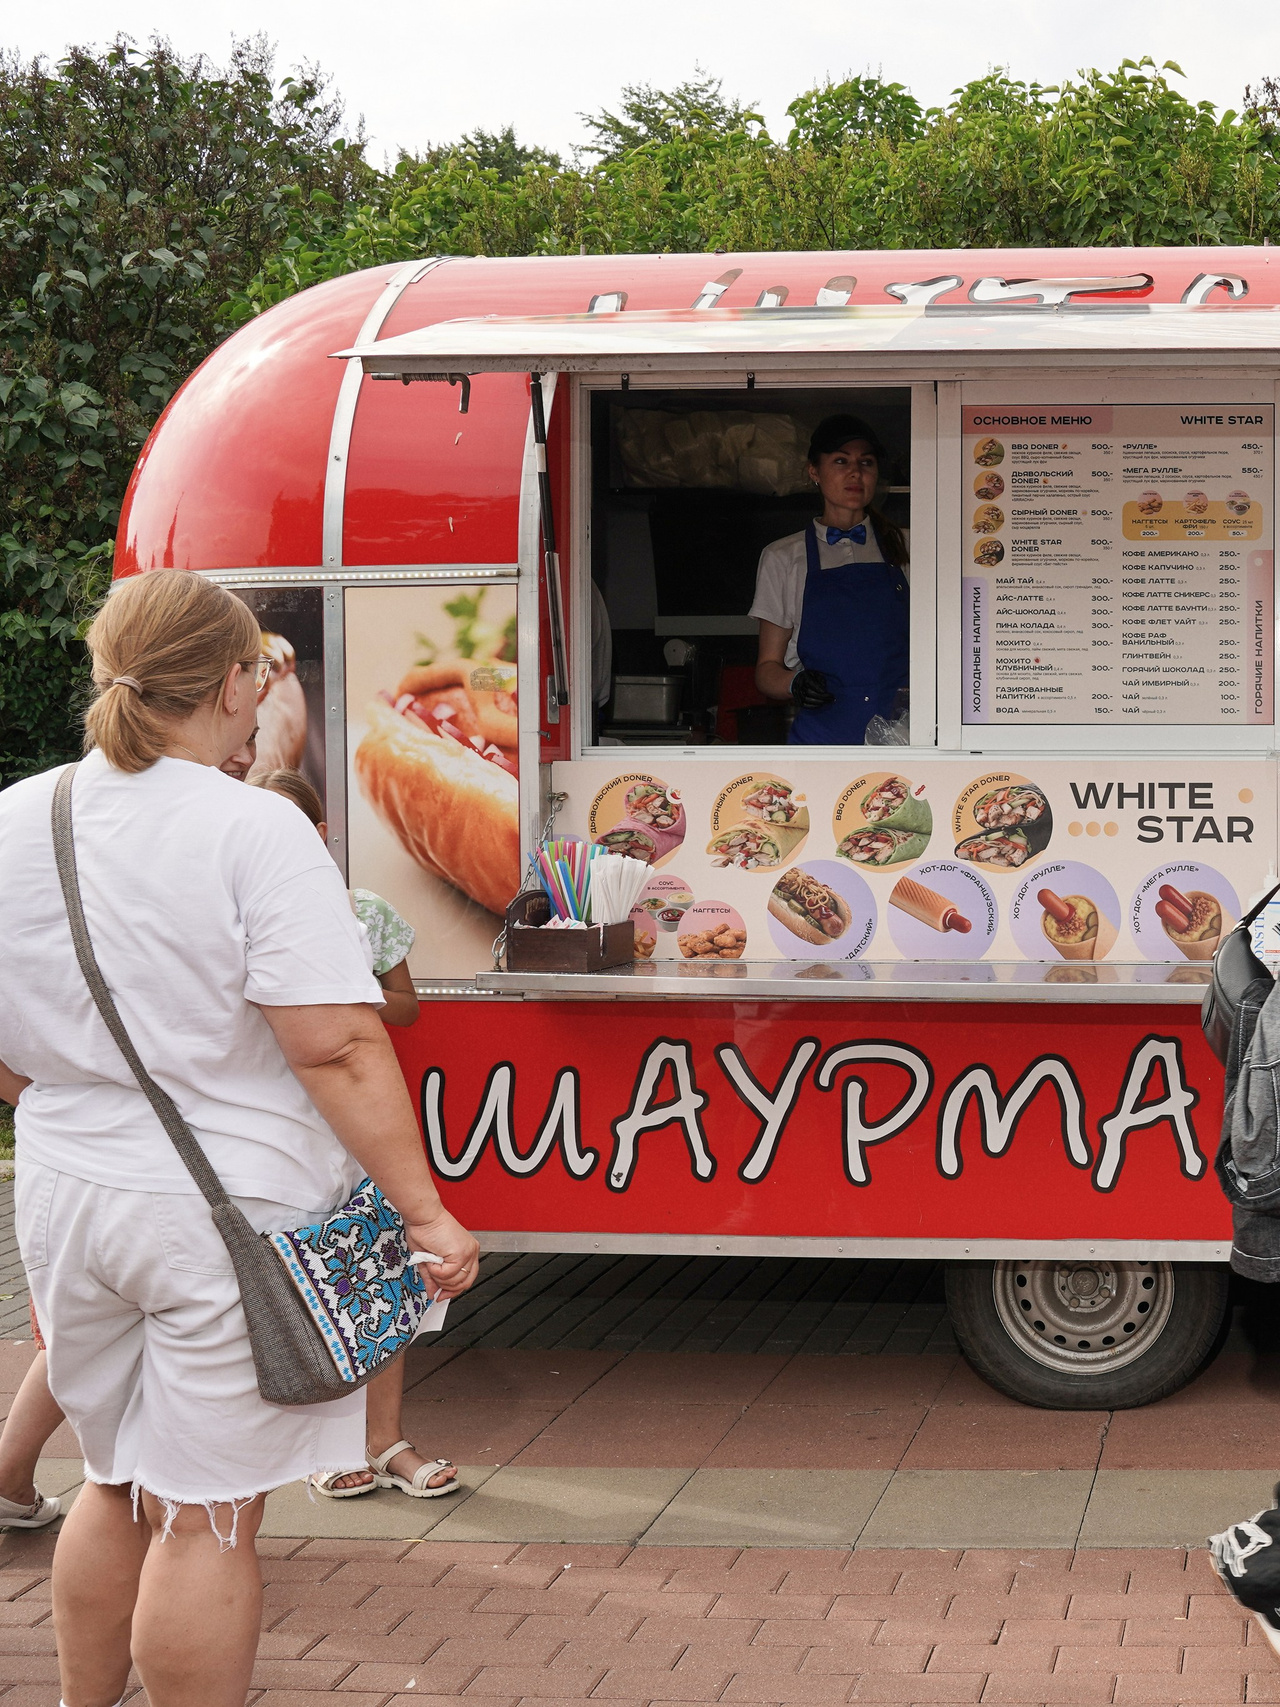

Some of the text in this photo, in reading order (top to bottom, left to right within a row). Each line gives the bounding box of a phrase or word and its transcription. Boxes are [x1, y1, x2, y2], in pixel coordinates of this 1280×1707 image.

[973, 416, 1092, 425] ОСНОВНОЕ МЕНЮ
[1180, 415, 1264, 425] WHITE STAR
[1011, 508, 1047, 516] СЫРНЫЙ
[996, 594, 1044, 602] АЙС-ЛАТТЕ
[996, 608, 1056, 616] АЙС-ШОКОЛАД
[973, 586, 981, 713] ХОЛОДНЫЕ НАПИТКИ
[1255, 600, 1263, 714] ГОРЯЧИЕ НАПИТКИ
[590, 777, 622, 834] ДЬЯВОЛЬСКИЙ
[713, 776, 753, 831] СЫРНЫЙ DONER
[836, 779, 867, 821] BBQ DONER
[955, 775, 1010, 833] WHITE STAR DONER
[1069, 782, 1214, 810] WHITE
[1136, 815, 1255, 844] STAR
[919, 864, 995, 936] ХОТ-ДОГ «ФРАНЦУЗСКИЙ»
[1013, 864, 1066, 919] ХОТ-ДОГ «РУЛЛЕ»
[1133, 865, 1200, 934] ХОТ-ДОГ «МЕГА РУЛЛЕ»
[421, 1034, 1205, 1194] ШАУРМА
